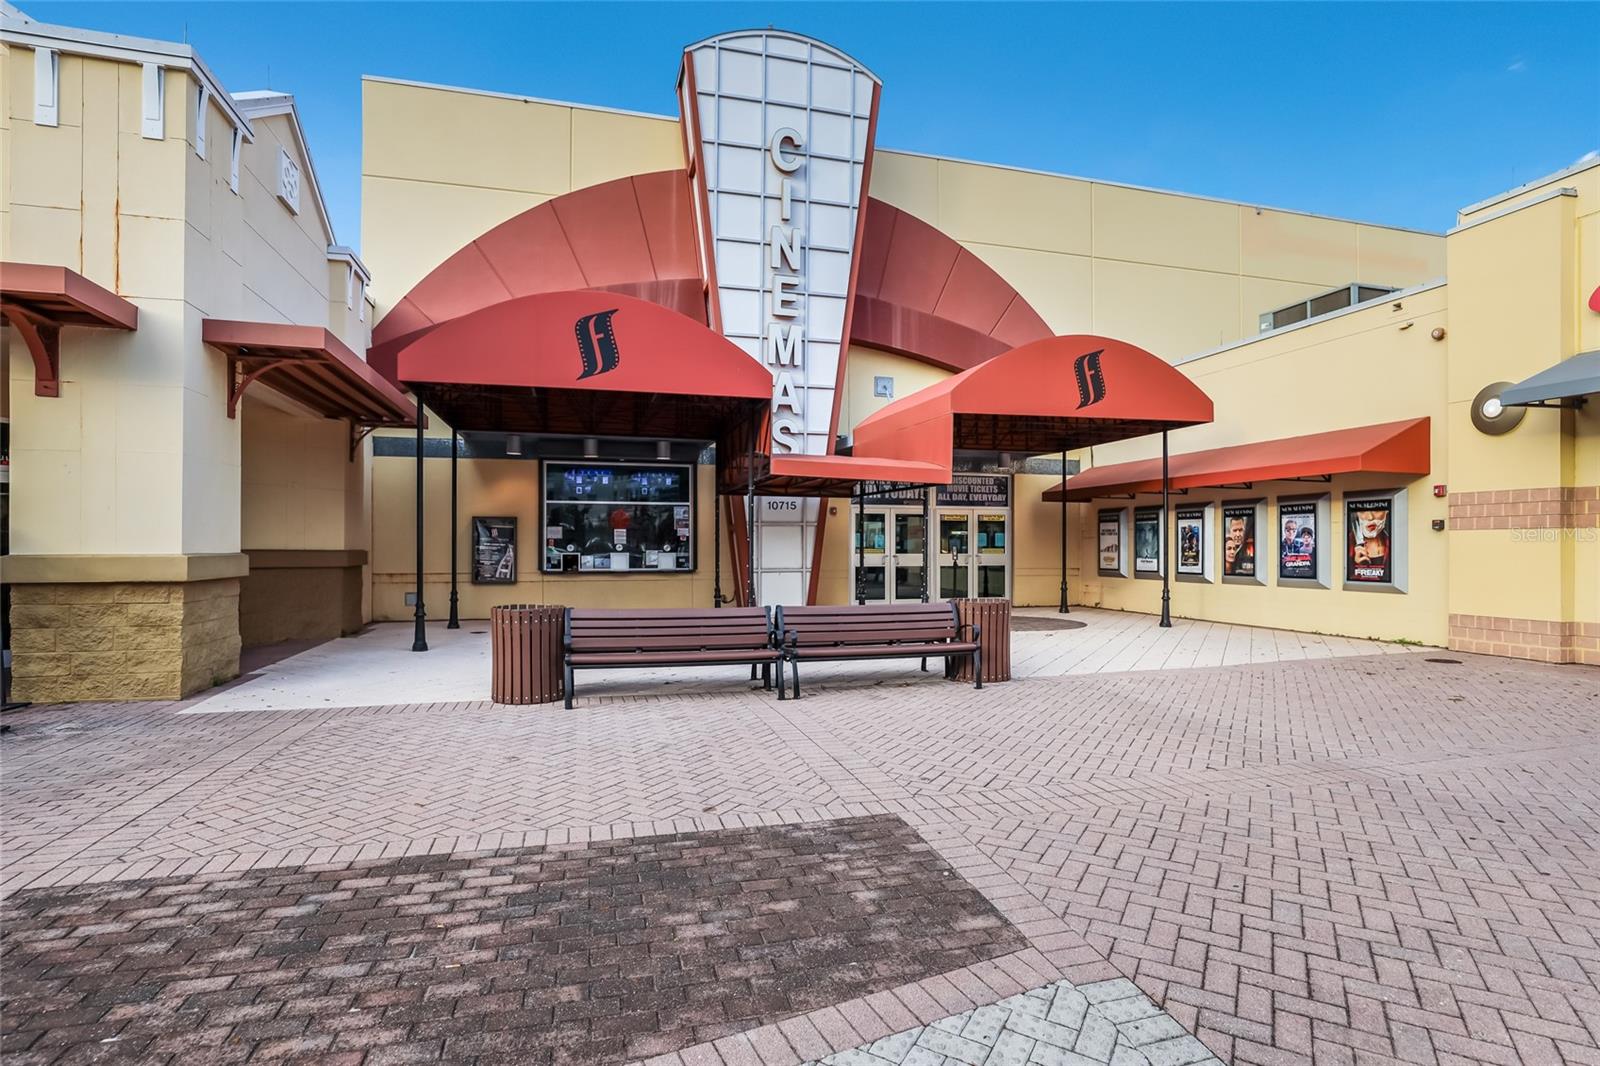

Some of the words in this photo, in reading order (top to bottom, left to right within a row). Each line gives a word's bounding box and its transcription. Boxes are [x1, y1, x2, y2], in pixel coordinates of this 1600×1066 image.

[769, 127, 802, 455] CINEMAS
[947, 485, 969, 493] MOVIE
[970, 485, 998, 493] TICKETS
[969, 494, 1007, 502] EVERYDAY
[768, 501, 797, 510] 10715
[1354, 568, 1385, 577] FREAKY
